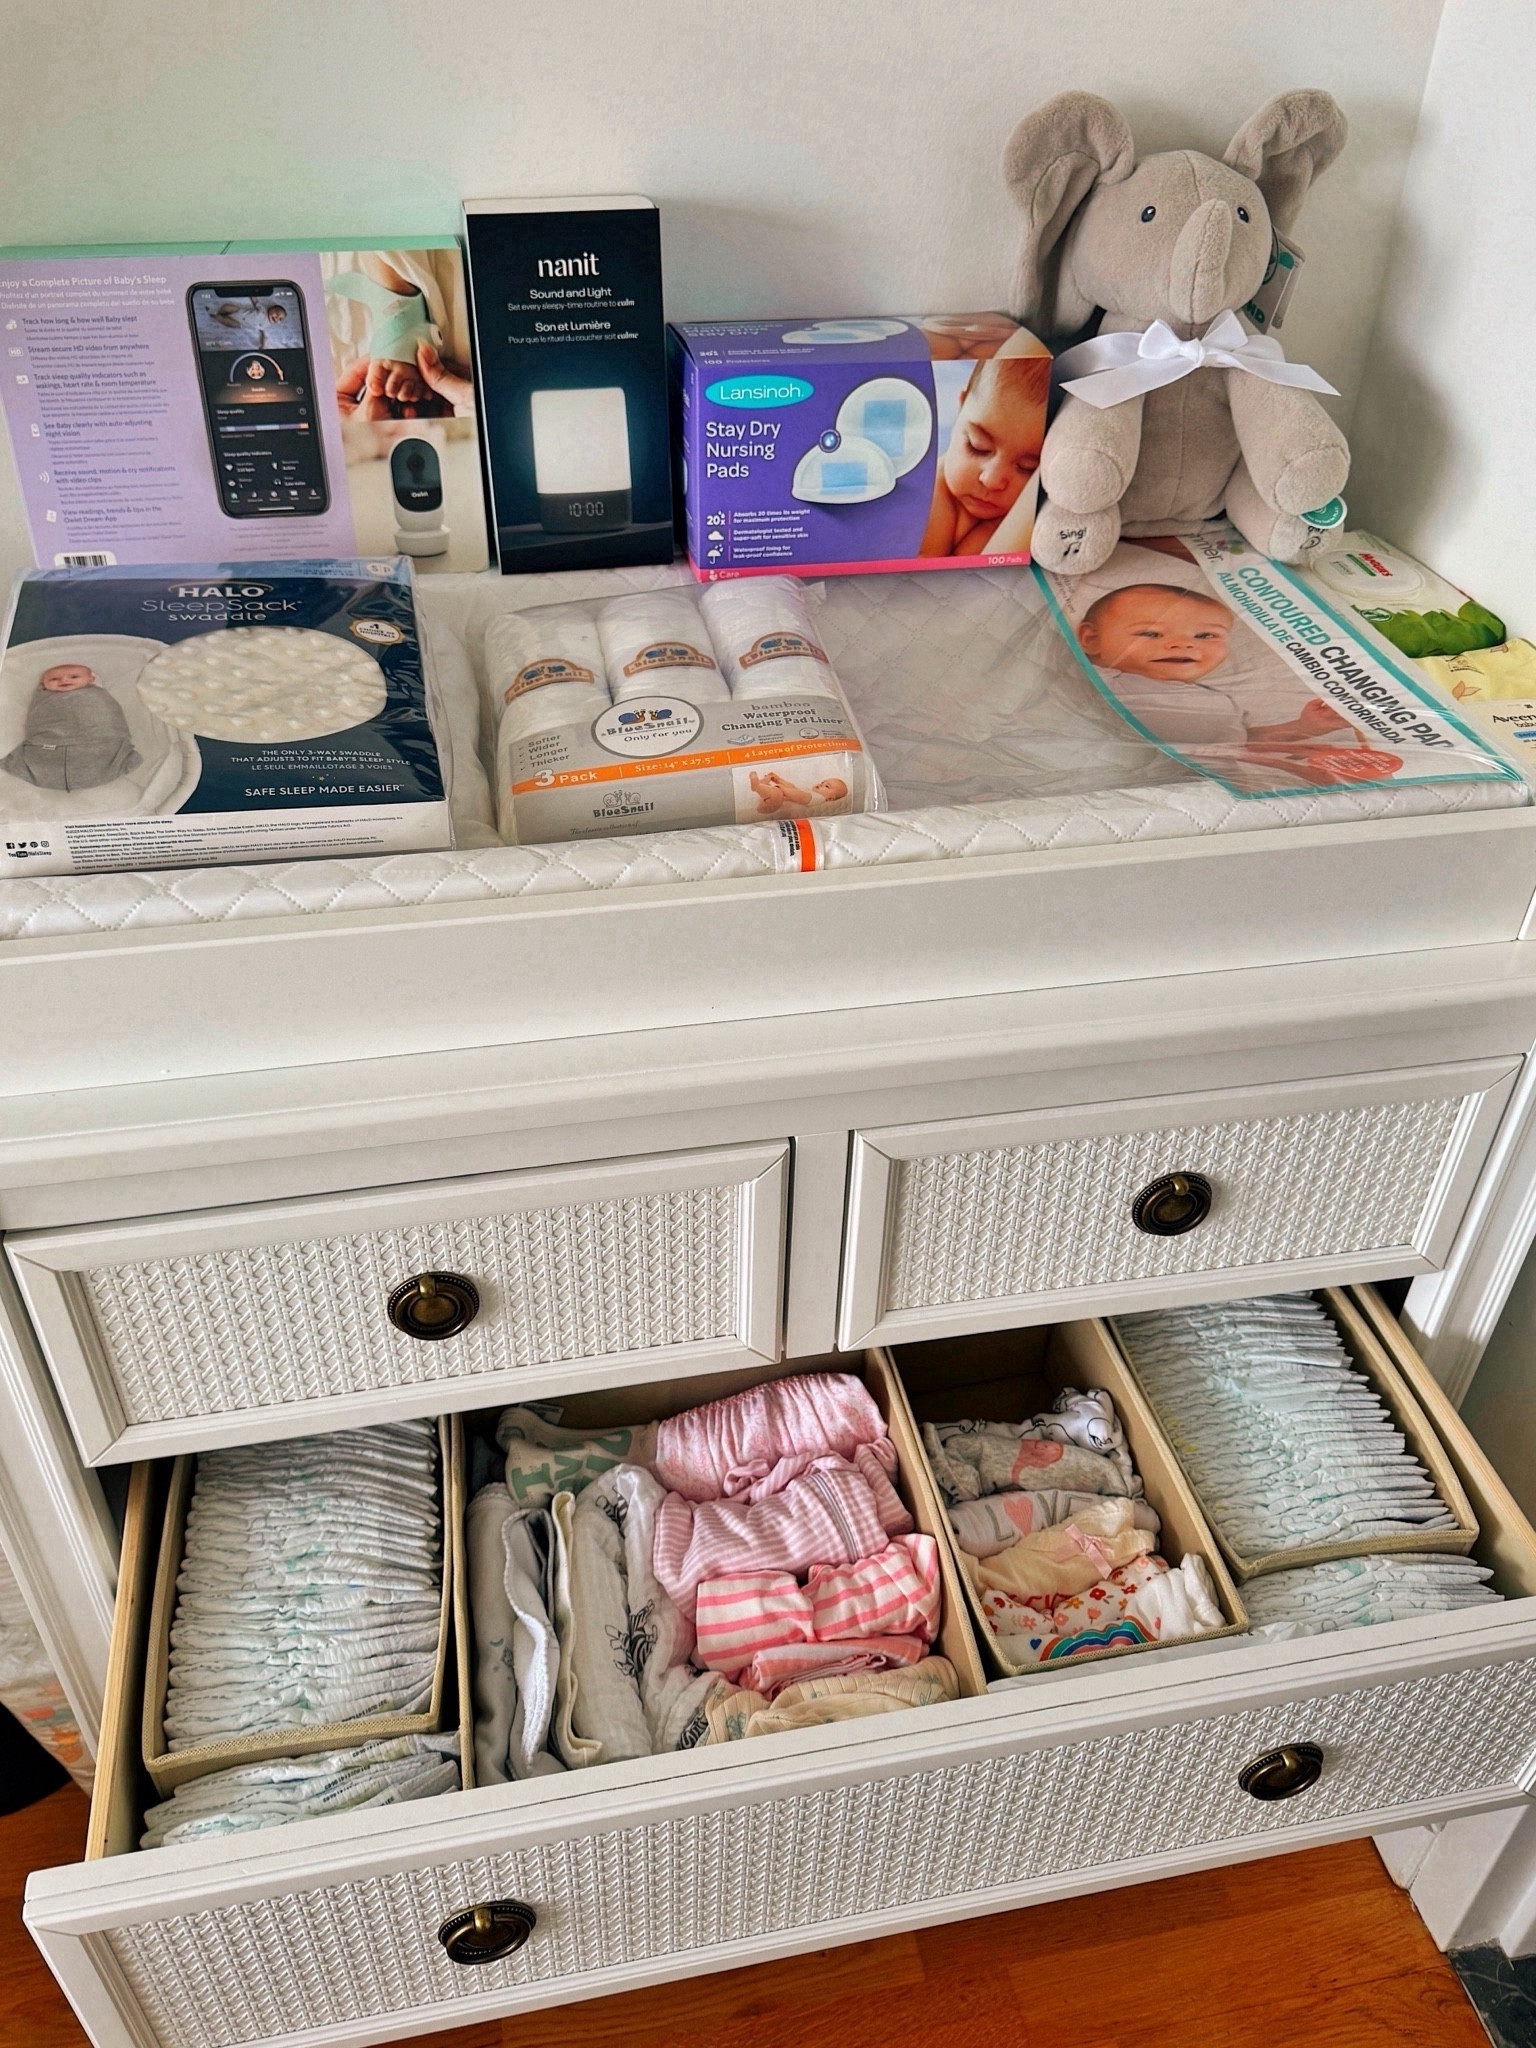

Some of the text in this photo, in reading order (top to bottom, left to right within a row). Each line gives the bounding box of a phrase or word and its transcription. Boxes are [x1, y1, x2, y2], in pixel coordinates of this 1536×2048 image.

[538, 252, 600, 277] nanit
[21, 279, 27, 287] a
[28, 277, 69, 287] Complete
[71, 276, 101, 286] Picture
[103, 276, 112, 285] of
[113, 275, 141, 286] Baby's
[142, 275, 166, 285] Sleep
[529, 286, 611, 299] Sound and Light
[507, 302, 520, 311] Set
[521, 303, 541, 311] every
[541, 301, 583, 310] sleepy-time
[583, 300, 608, 308] routine
[616, 298, 634, 307] calm
[21, 317, 39, 325] Track
[54, 317, 69, 325] long
[90, 315, 104, 323] well
[105, 315, 121, 323] Baby
[535, 319, 611, 332] Son et Lumière
[508, 335, 524, 344] Pour
[525, 336, 539, 344] que
[539, 335, 546, 343] le
[565, 333, 574, 342] du
[575, 333, 602, 341] coucher
[616, 331, 638, 339] calme
[27, 345, 50, 353] Stream
[119, 343, 149, 351] anywhere
[33, 372, 50, 380] Track
[69, 372, 90, 380] quality
[91, 371, 122, 379] indicators
[123, 370, 138, 378] such
[35, 382, 62, 390] wakings,
[94, 379, 100, 387] &
[720, 384, 801, 400] Lansinoh
[43, 421, 55, 429] See
[55, 421, 71, 429] Baby
[108, 419, 152, 427] auto-adjusting
[705, 419, 781, 441] Stay Dry
[45, 430, 61, 438] night
[707, 442, 775, 460] Nursing
[707, 462, 749, 478] Pads
[569, 501, 605, 517] 10:00
[733, 527, 772, 535] Dermatologist
[1060, 527, 1087, 540] Sing!
[178, 587, 266, 598] HALO
[168, 612, 267, 621] swaddle
[1237, 567, 1331, 648] CONTOURED
[1320, 646, 1417, 725] CHANGING
[1216, 571, 1407, 744] ALMOHADILLA DE CAMBIO CONTORNEADA
[751, 702, 810, 710] bamboo
[743, 709, 816, 719] Waterproof
[1493, 715, 1536, 723] Aveen
[606, 717, 689, 735] BlueSnail
[721, 719, 782, 731] Changing
[810, 715, 842, 725] Liner
[672, 729, 692, 737] you
[528, 735, 561, 748] Softer
[528, 741, 560, 753] Wider
[529, 747, 568, 760] Longer
[752, 748, 782, 758] Layers
[784, 745, 795, 753] of
[796, 741, 847, 751] Protection
[386, 758, 411, 766] STYLE
[531, 754, 570, 768] Thicker
[635, 764, 662, 773] Size:
[534, 769, 597, 787] 3 Pack
[245, 787, 275, 796] SAFE
[279, 785, 315, 795] SLEEP
[319, 784, 354, 794] MADE
[592, 802, 654, 818] BlueSnail
